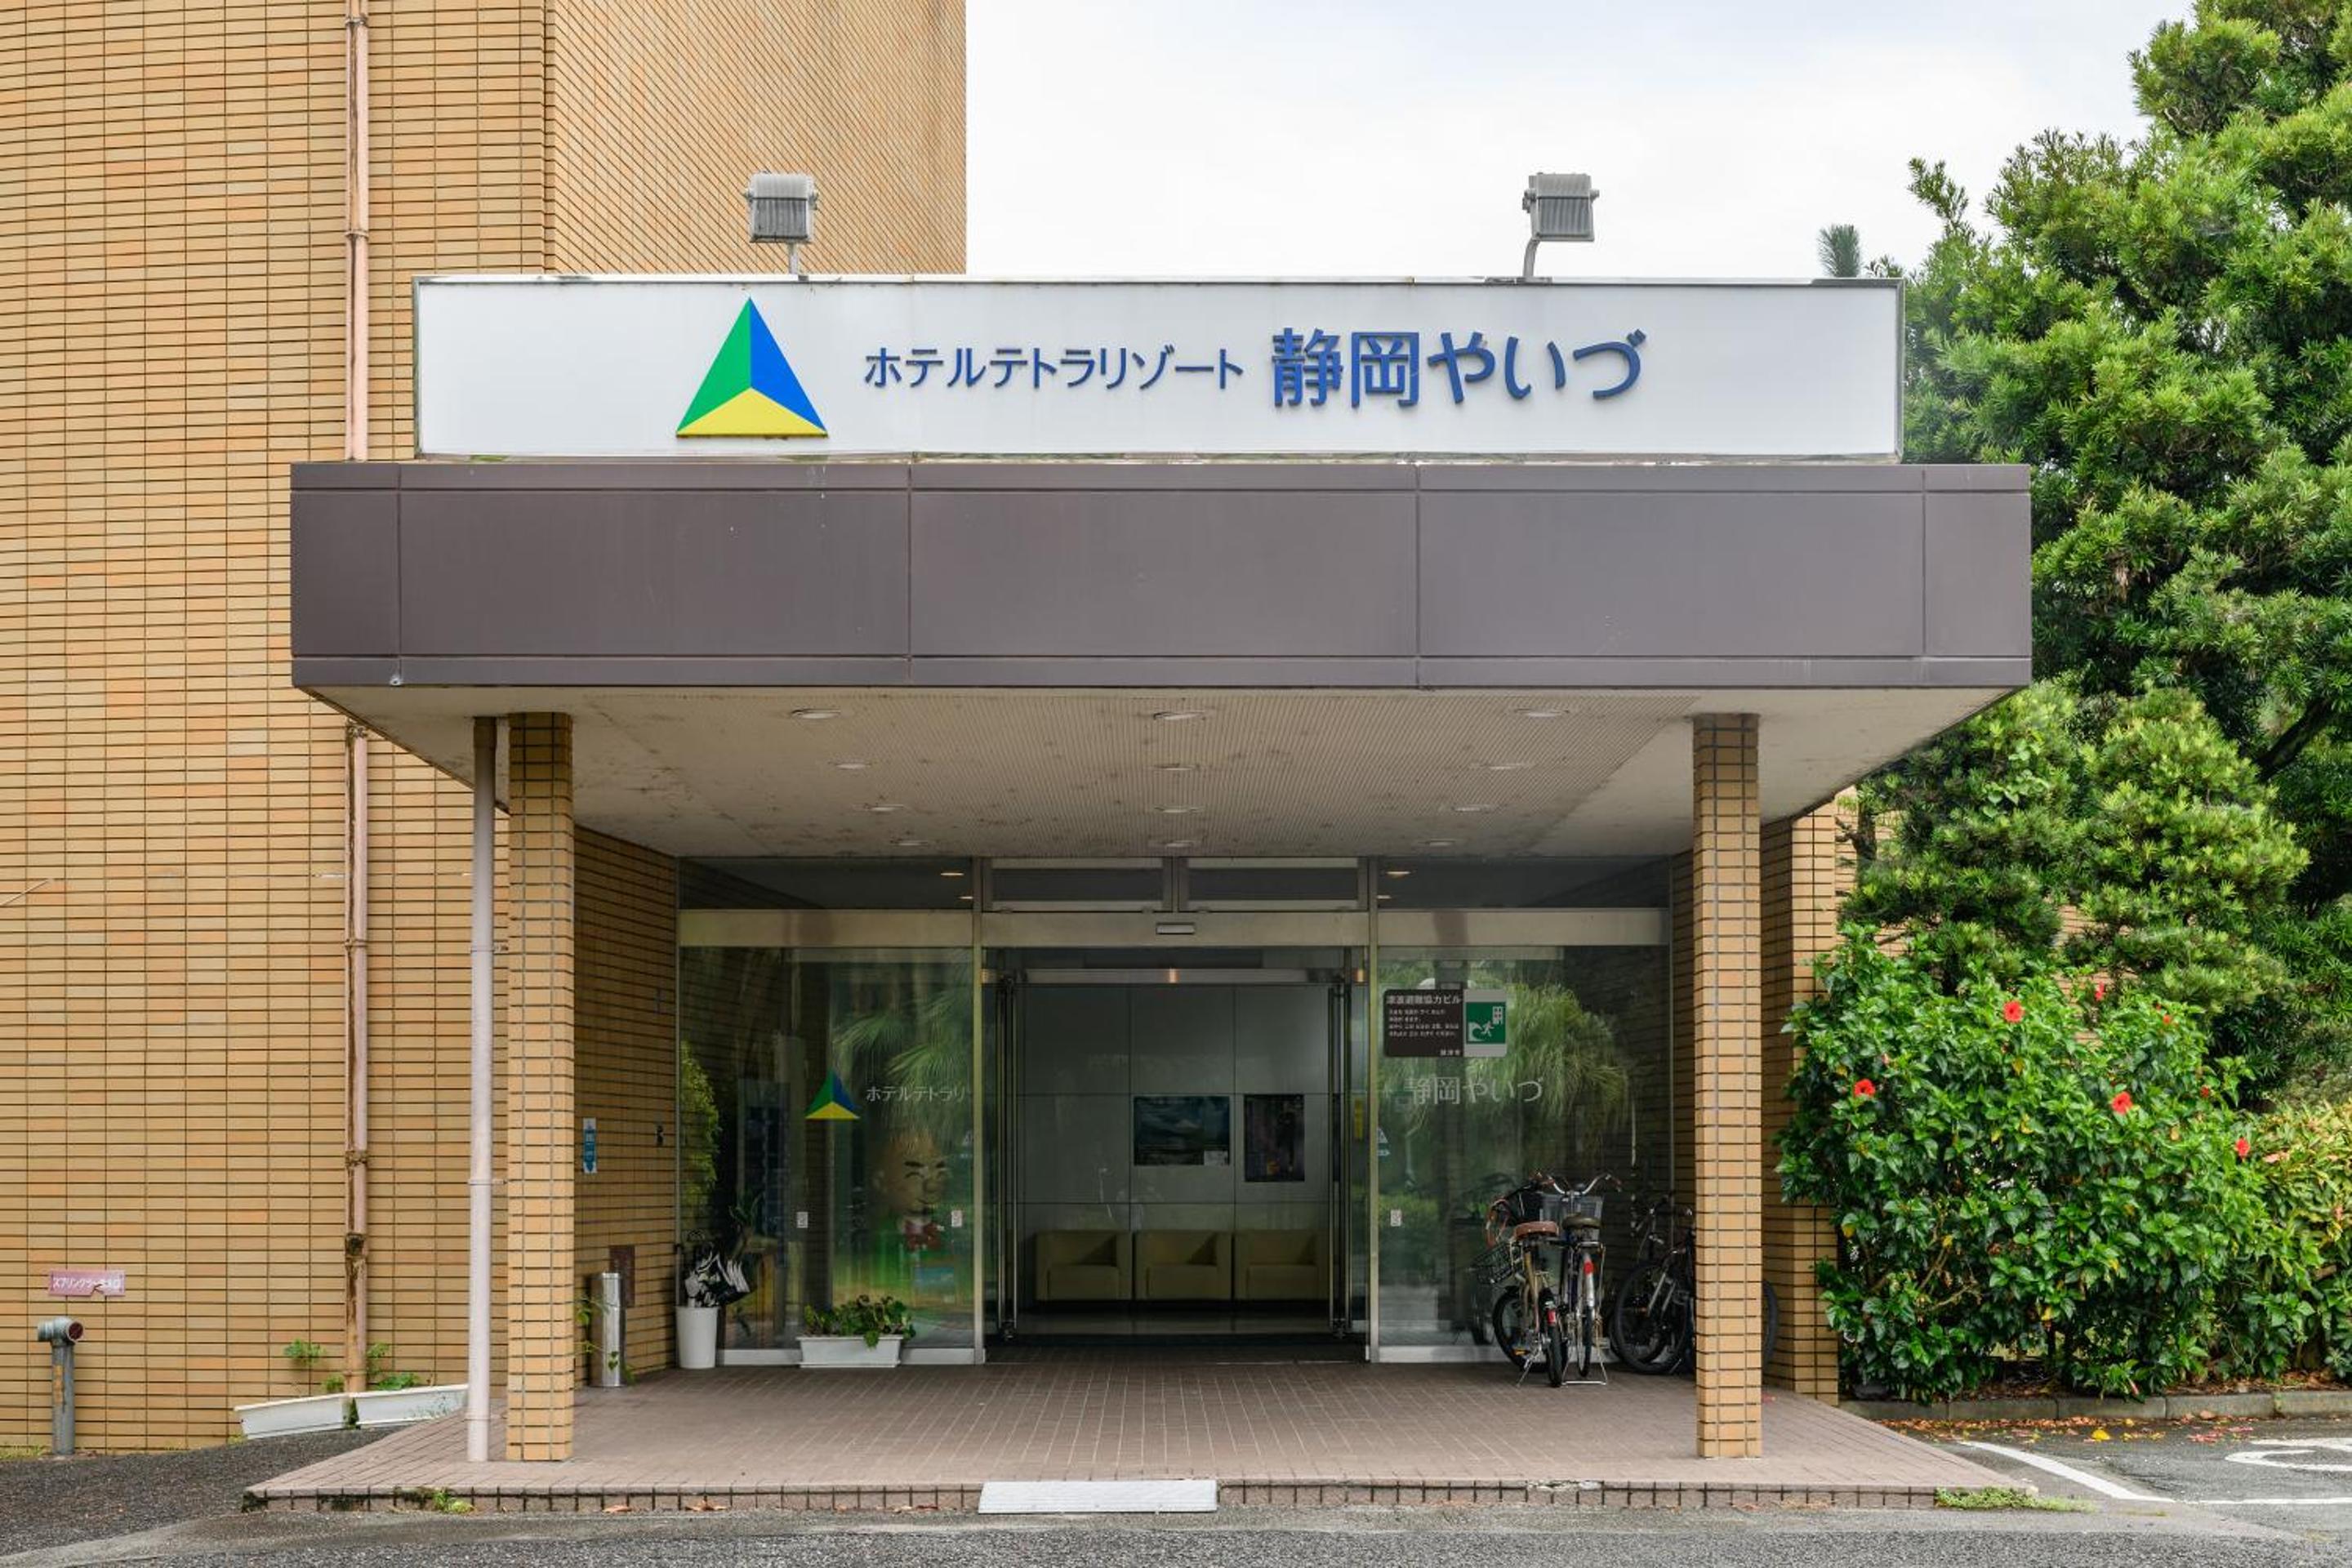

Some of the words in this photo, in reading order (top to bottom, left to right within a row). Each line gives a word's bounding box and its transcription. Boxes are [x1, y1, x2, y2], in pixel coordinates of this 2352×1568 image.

[864, 347, 1244, 390] ホテルテトラリゾート
[1272, 327, 1646, 408] 静岡やいづ
[1403, 1074, 1544, 1105] 静岡やいづ
